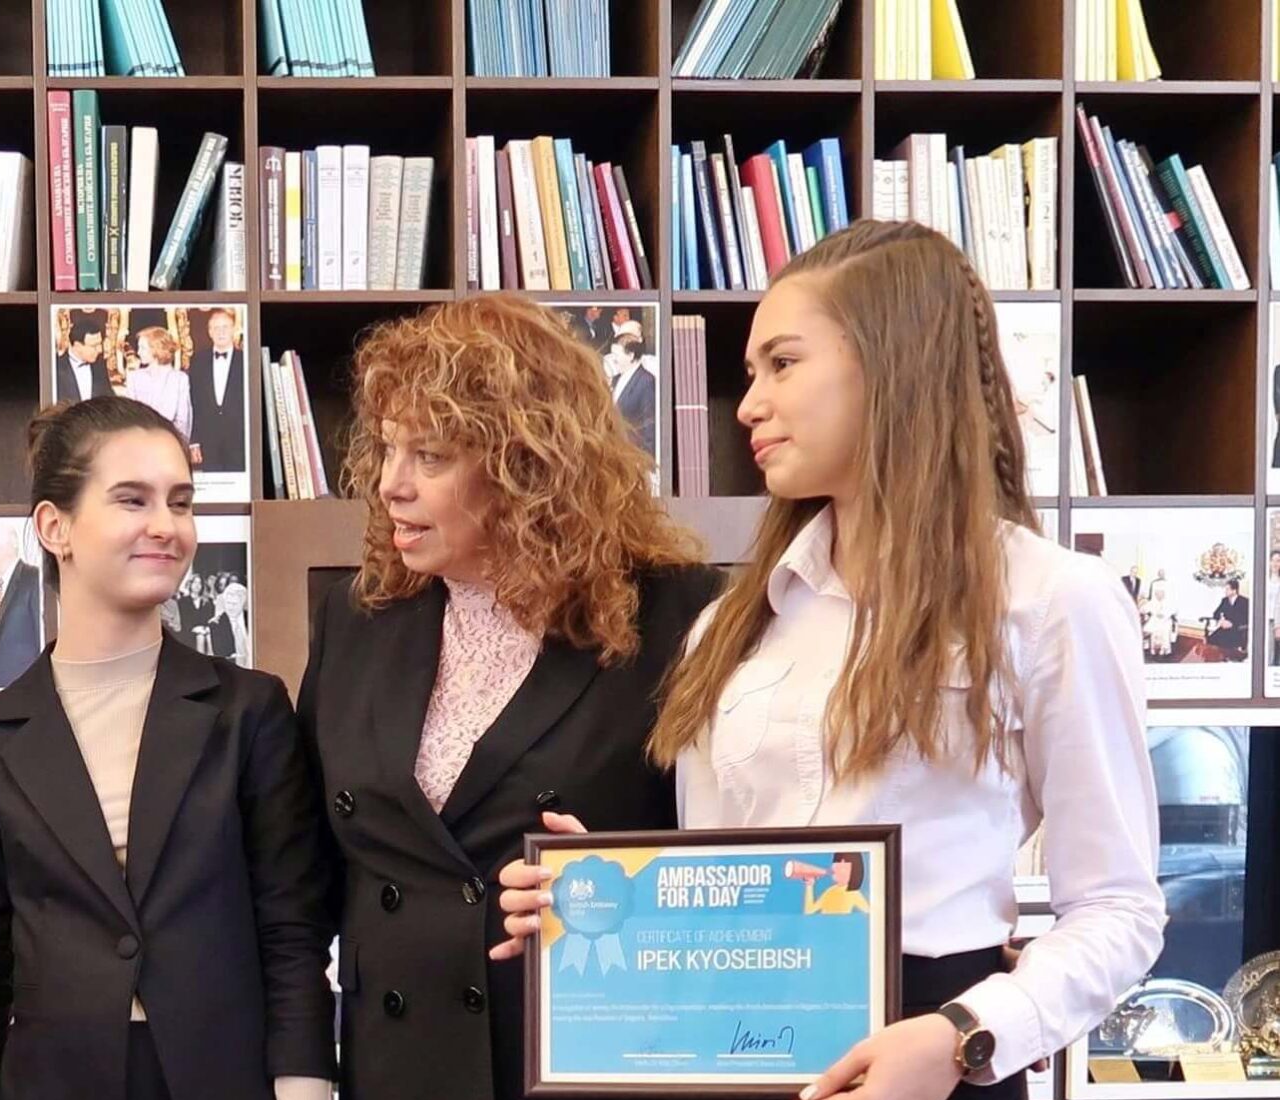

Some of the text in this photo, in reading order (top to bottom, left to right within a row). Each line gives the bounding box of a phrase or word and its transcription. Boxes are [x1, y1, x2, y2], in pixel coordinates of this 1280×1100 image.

[229, 166, 243, 228] ЧОВЕК
[657, 864, 772, 888] AMBASSADOR
[658, 886, 741, 908] FOR A DAY
[637, 929, 773, 944] CERTIFICATE OF ACHIEVEMENT
[637, 948, 812, 971] IPEK KYOSEIBISH
